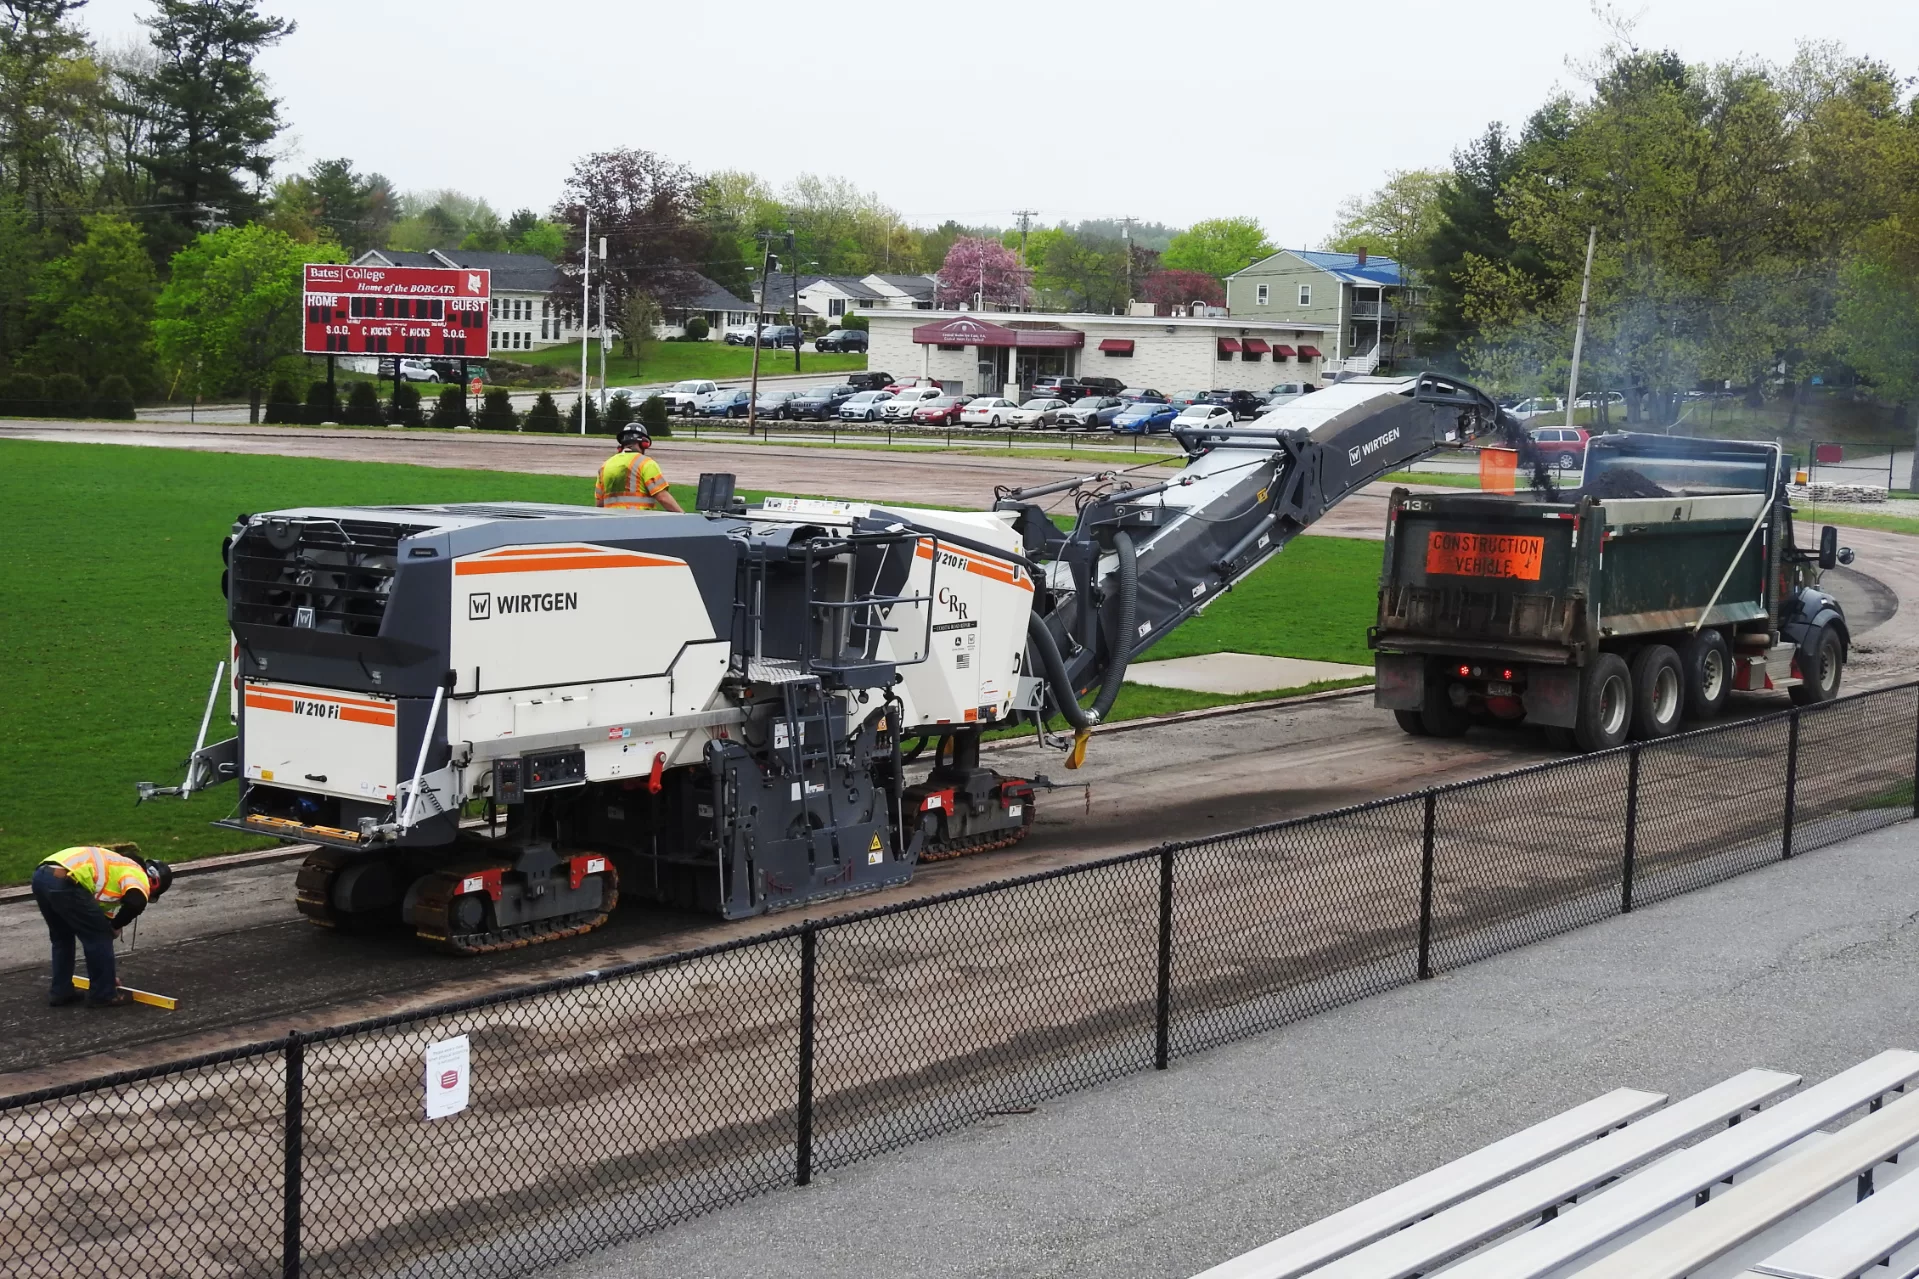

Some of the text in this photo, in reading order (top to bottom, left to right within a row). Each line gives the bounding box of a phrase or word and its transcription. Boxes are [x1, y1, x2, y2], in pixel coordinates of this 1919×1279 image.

[310, 267, 385, 282] Bates College
[357, 282, 456, 294] Home of the BOBCATS
[307, 295, 338, 307] HOME
[451, 300, 487, 312] GUEST
[326, 325, 351, 335] S.O.G.
[362, 326, 392, 336] C. KICKS
[401, 327, 431, 337] C. KICKS
[442, 328, 467, 338] S.O.G.
[1362, 426, 1400, 456] WIRTGEN
[1433, 534, 1539, 555] CONSTRUCTION
[942, 553, 957, 567] 210
[958, 558, 967, 571] Fi
[1456, 557, 1512, 575] VEHICLE
[497, 592, 577, 614] WIRTGEN
[938, 587, 968, 620] CRR
[294, 700, 339, 719] W 210 Fi
